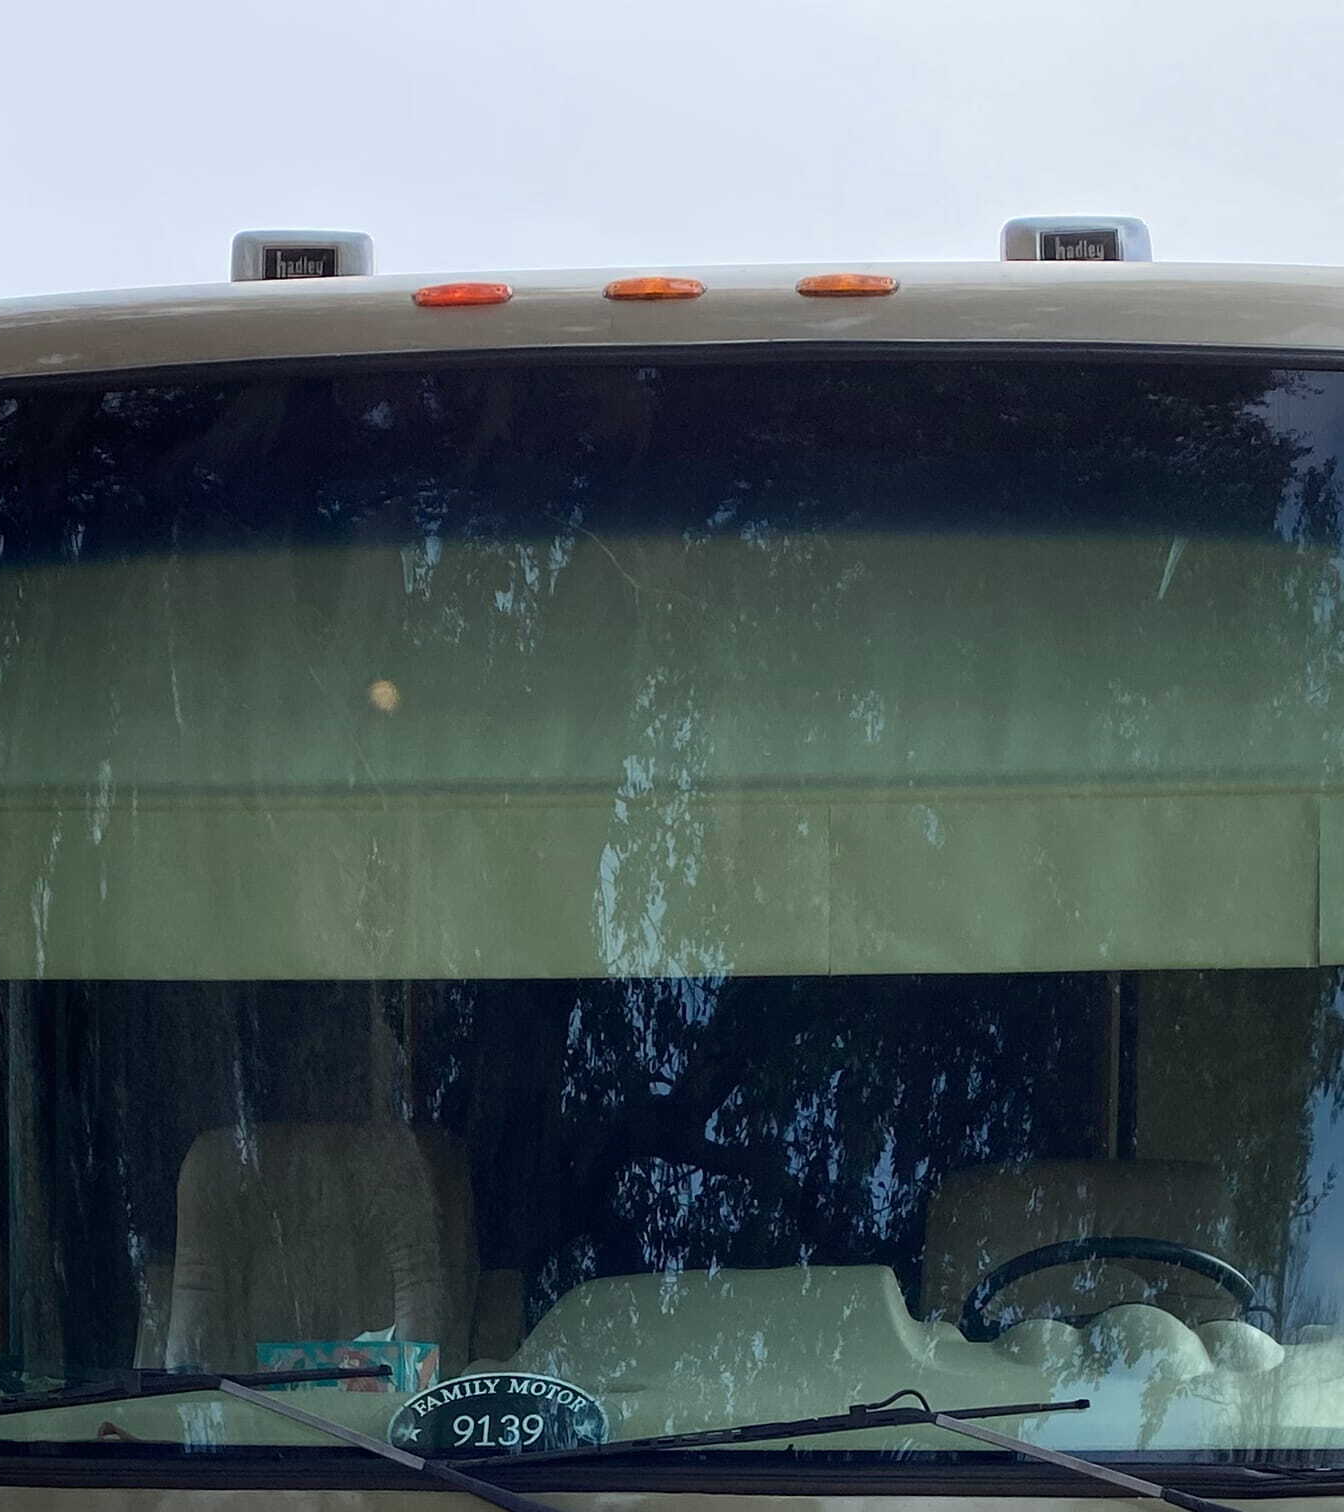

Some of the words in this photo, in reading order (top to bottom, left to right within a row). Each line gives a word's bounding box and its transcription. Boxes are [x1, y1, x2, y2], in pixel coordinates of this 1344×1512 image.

[1055, 236, 1105, 260] hadley
[276, 250, 326, 278] hadley
[413, 1378, 501, 1417] FAMILY
[508, 1378, 588, 1412] MOTOR
[453, 1414, 544, 1447] 9139
